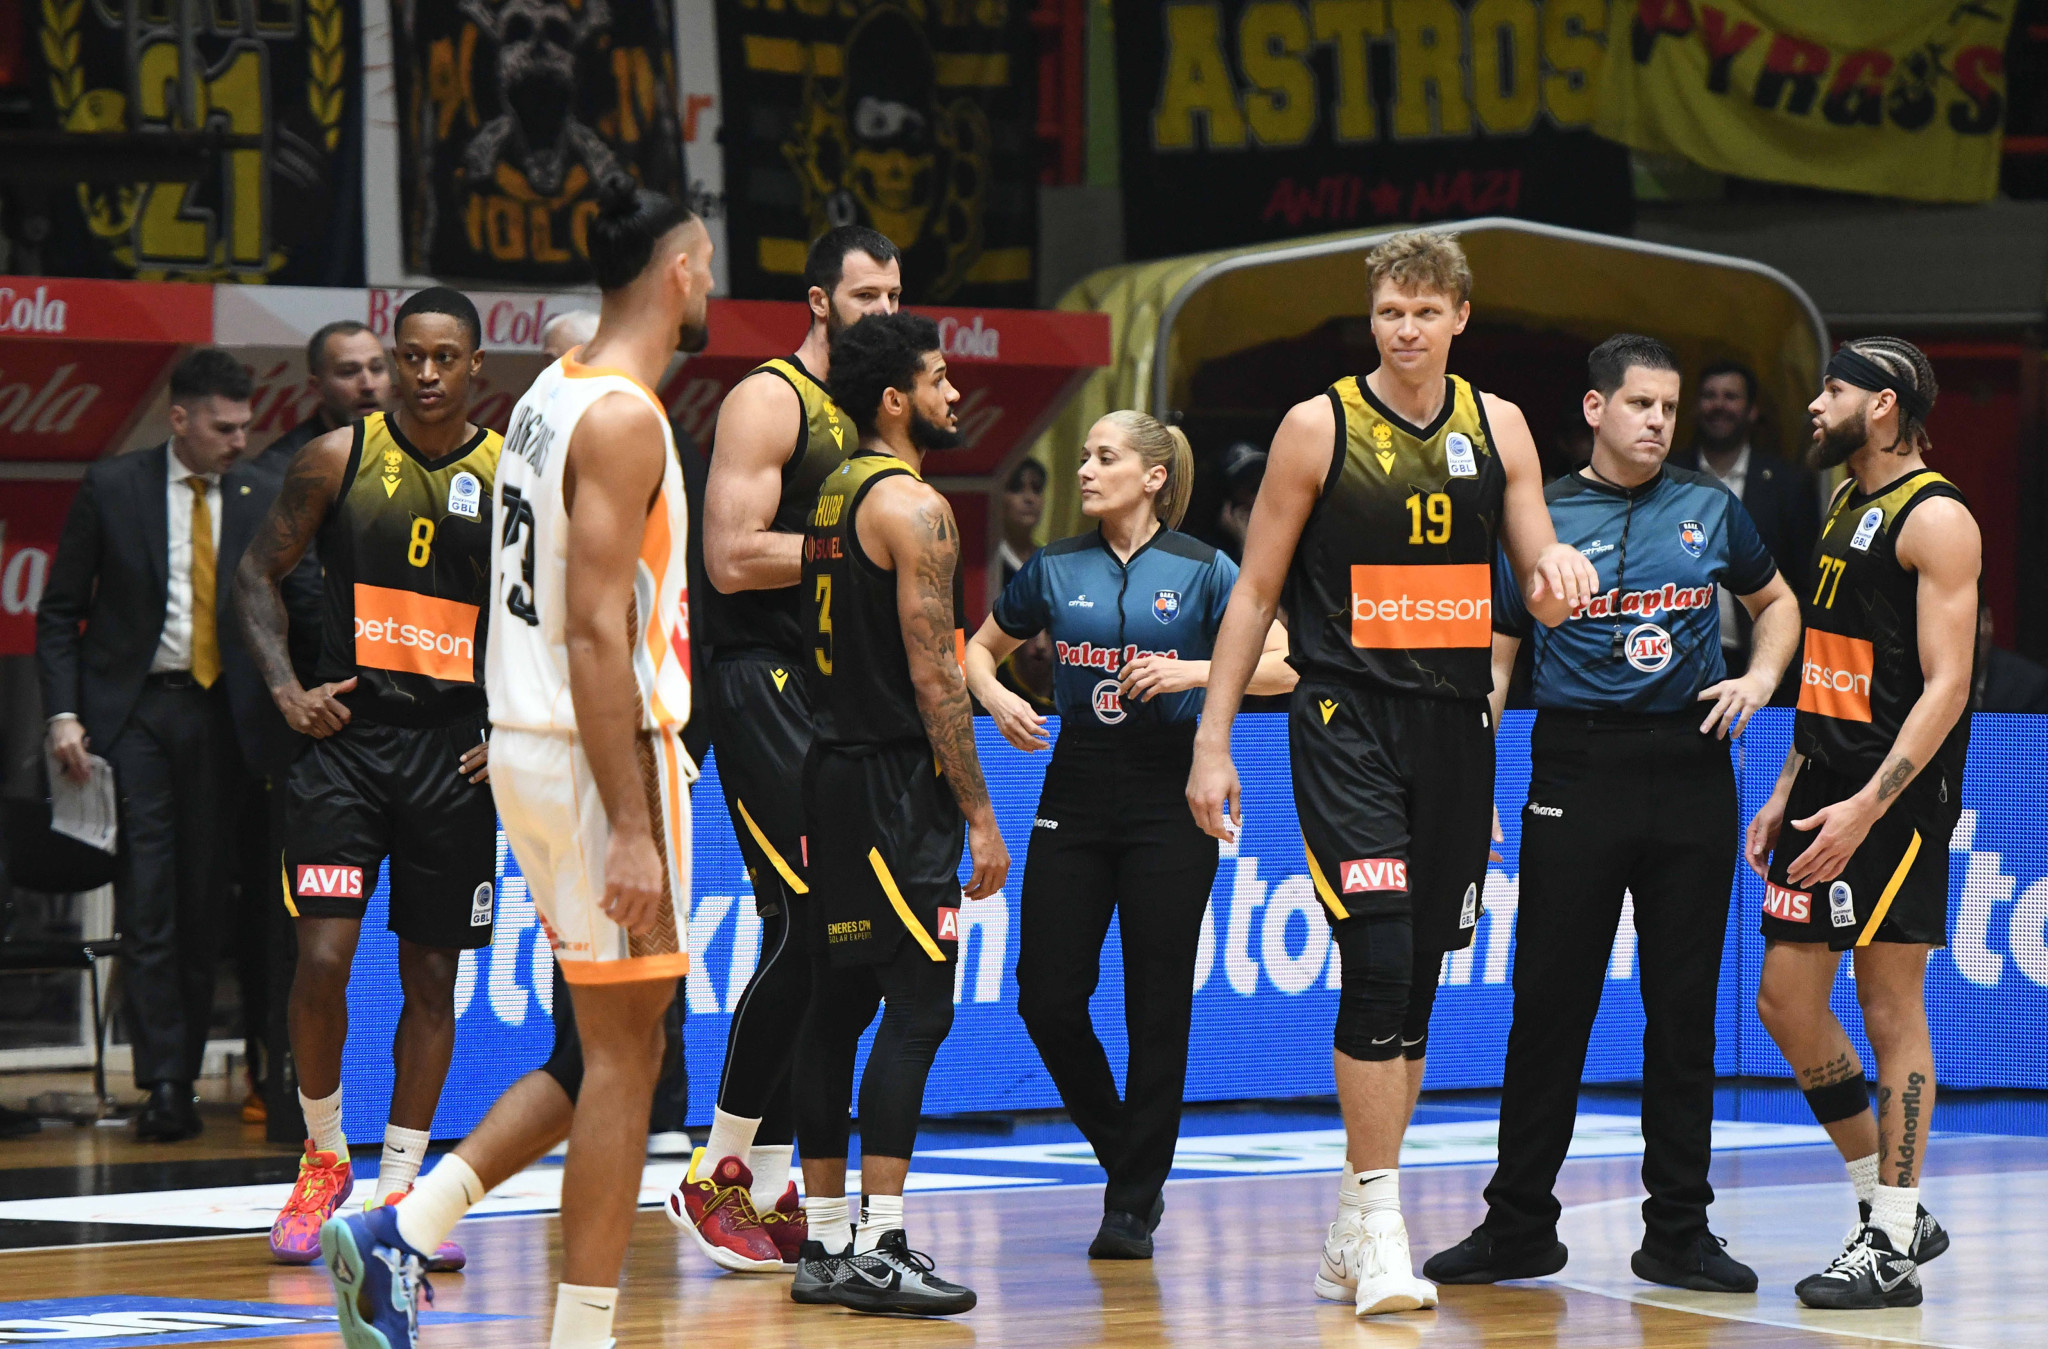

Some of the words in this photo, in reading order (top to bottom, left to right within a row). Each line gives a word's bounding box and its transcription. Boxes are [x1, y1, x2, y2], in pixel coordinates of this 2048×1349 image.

[1150, 0, 1606, 152] ASTROS
[1260, 174, 1364, 225] ANTI
[1409, 169, 1523, 219] NAZI
[938, 315, 1000, 359] Cola
[1451, 464, 1474, 473] GBL
[452, 501, 475, 514] GBL
[814, 494, 844, 527] HUBB
[1405, 492, 1453, 545] 19
[407, 516, 436, 568] 8
[1853, 536, 1867, 548] GBL
[1812, 554, 1847, 610] 77
[1352, 592, 1491, 623] betsson
[814, 573, 833, 677] 3
[1631, 636, 1669, 658] AK
[1034, 818, 1059, 830] ance
[299, 868, 362, 895] AVIS
[1344, 862, 1407, 890] AVIS
[473, 913, 490, 923] GBL
[828, 921, 857, 935] ENERES
[1461, 915, 1474, 926] GBL
[1833, 914, 1853, 924] GBL
[829, 934, 848, 944] SOLAR
